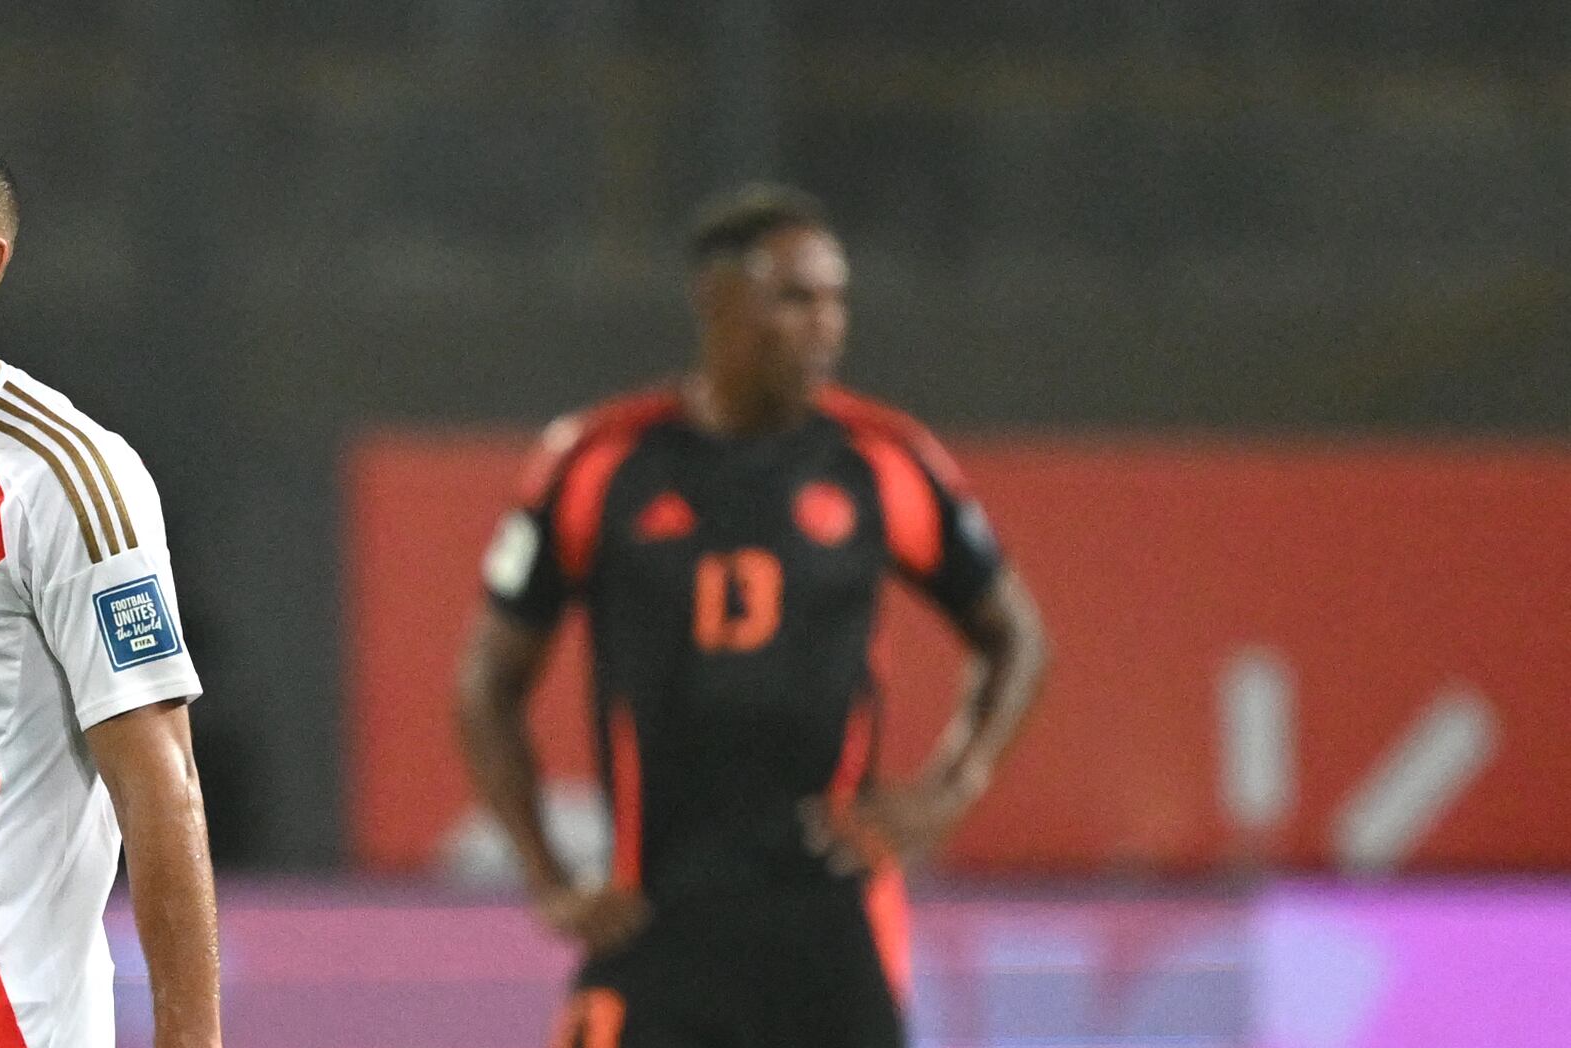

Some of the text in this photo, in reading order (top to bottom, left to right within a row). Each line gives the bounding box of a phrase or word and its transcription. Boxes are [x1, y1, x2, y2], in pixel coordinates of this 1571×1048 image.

[111, 592, 152, 613] FOOTBALL
[692, 549, 784, 651] 13
[113, 602, 157, 627] UNITES
[115, 616, 163, 641] the World
[133, 638, 153, 648] FIFA
